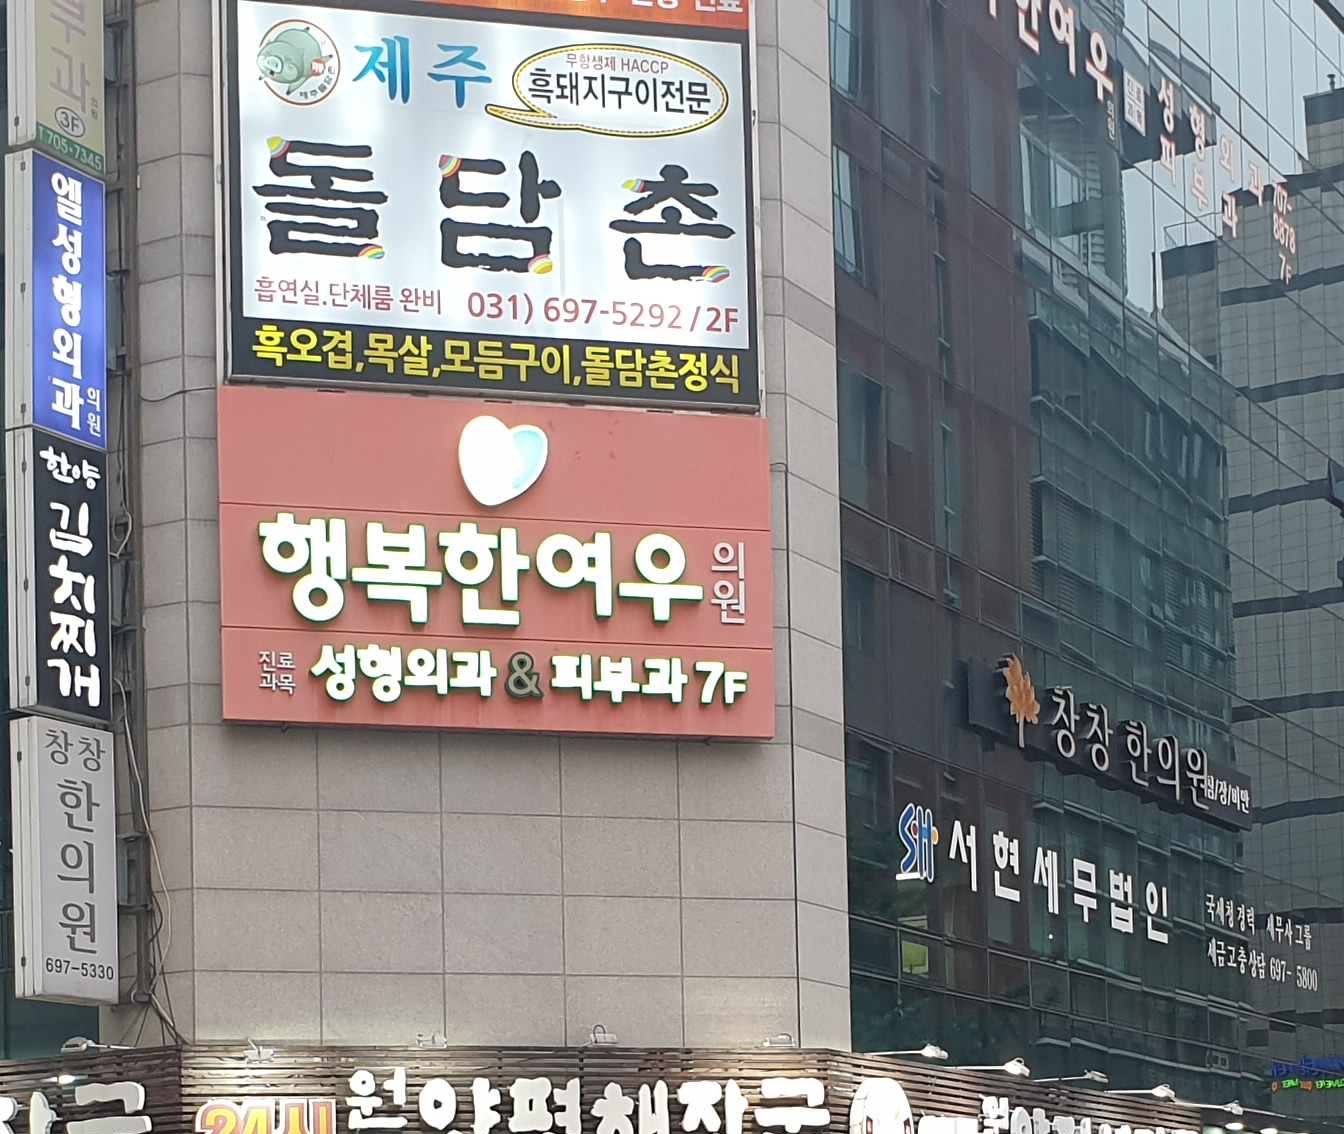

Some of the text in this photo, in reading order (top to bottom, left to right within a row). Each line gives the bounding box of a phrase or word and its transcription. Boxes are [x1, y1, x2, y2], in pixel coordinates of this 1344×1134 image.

[352, 36, 492, 108] 제주
[565, 52, 668, 74] 무항생제 HACCP
[527, 69, 710, 115] 흑돼지구이전문
[60, 112, 79, 132] 3F
[253, 135, 735, 283] 돌담촌
[1278, 253, 1292, 285] 7F
[51, 172, 84, 430] 엘성형외과
[400, 288, 443, 316] 완비
[468, 292, 533, 324] 031)
[87, 387, 100, 437] 의원
[260, 512, 703, 626] 행복한여우
[710, 541, 747, 625] 의원
[47, 503, 100, 707] 김치찌개
[258, 650, 295, 671] 진료
[258, 672, 296, 695] 과목
[309, 645, 748, 705] 성형외과 & 피부과 7F
[44, 728, 106, 772] 창창
[1052, 688, 1209, 810] 창창 한의원
[57, 779, 101, 954] 한의원
[949, 820, 1169, 943] 서현세무법인
[1206, 894, 1233, 928] 국세청
[1238, 904, 1254, 935] 경력
[46, 957, 114, 981] 697-5330
